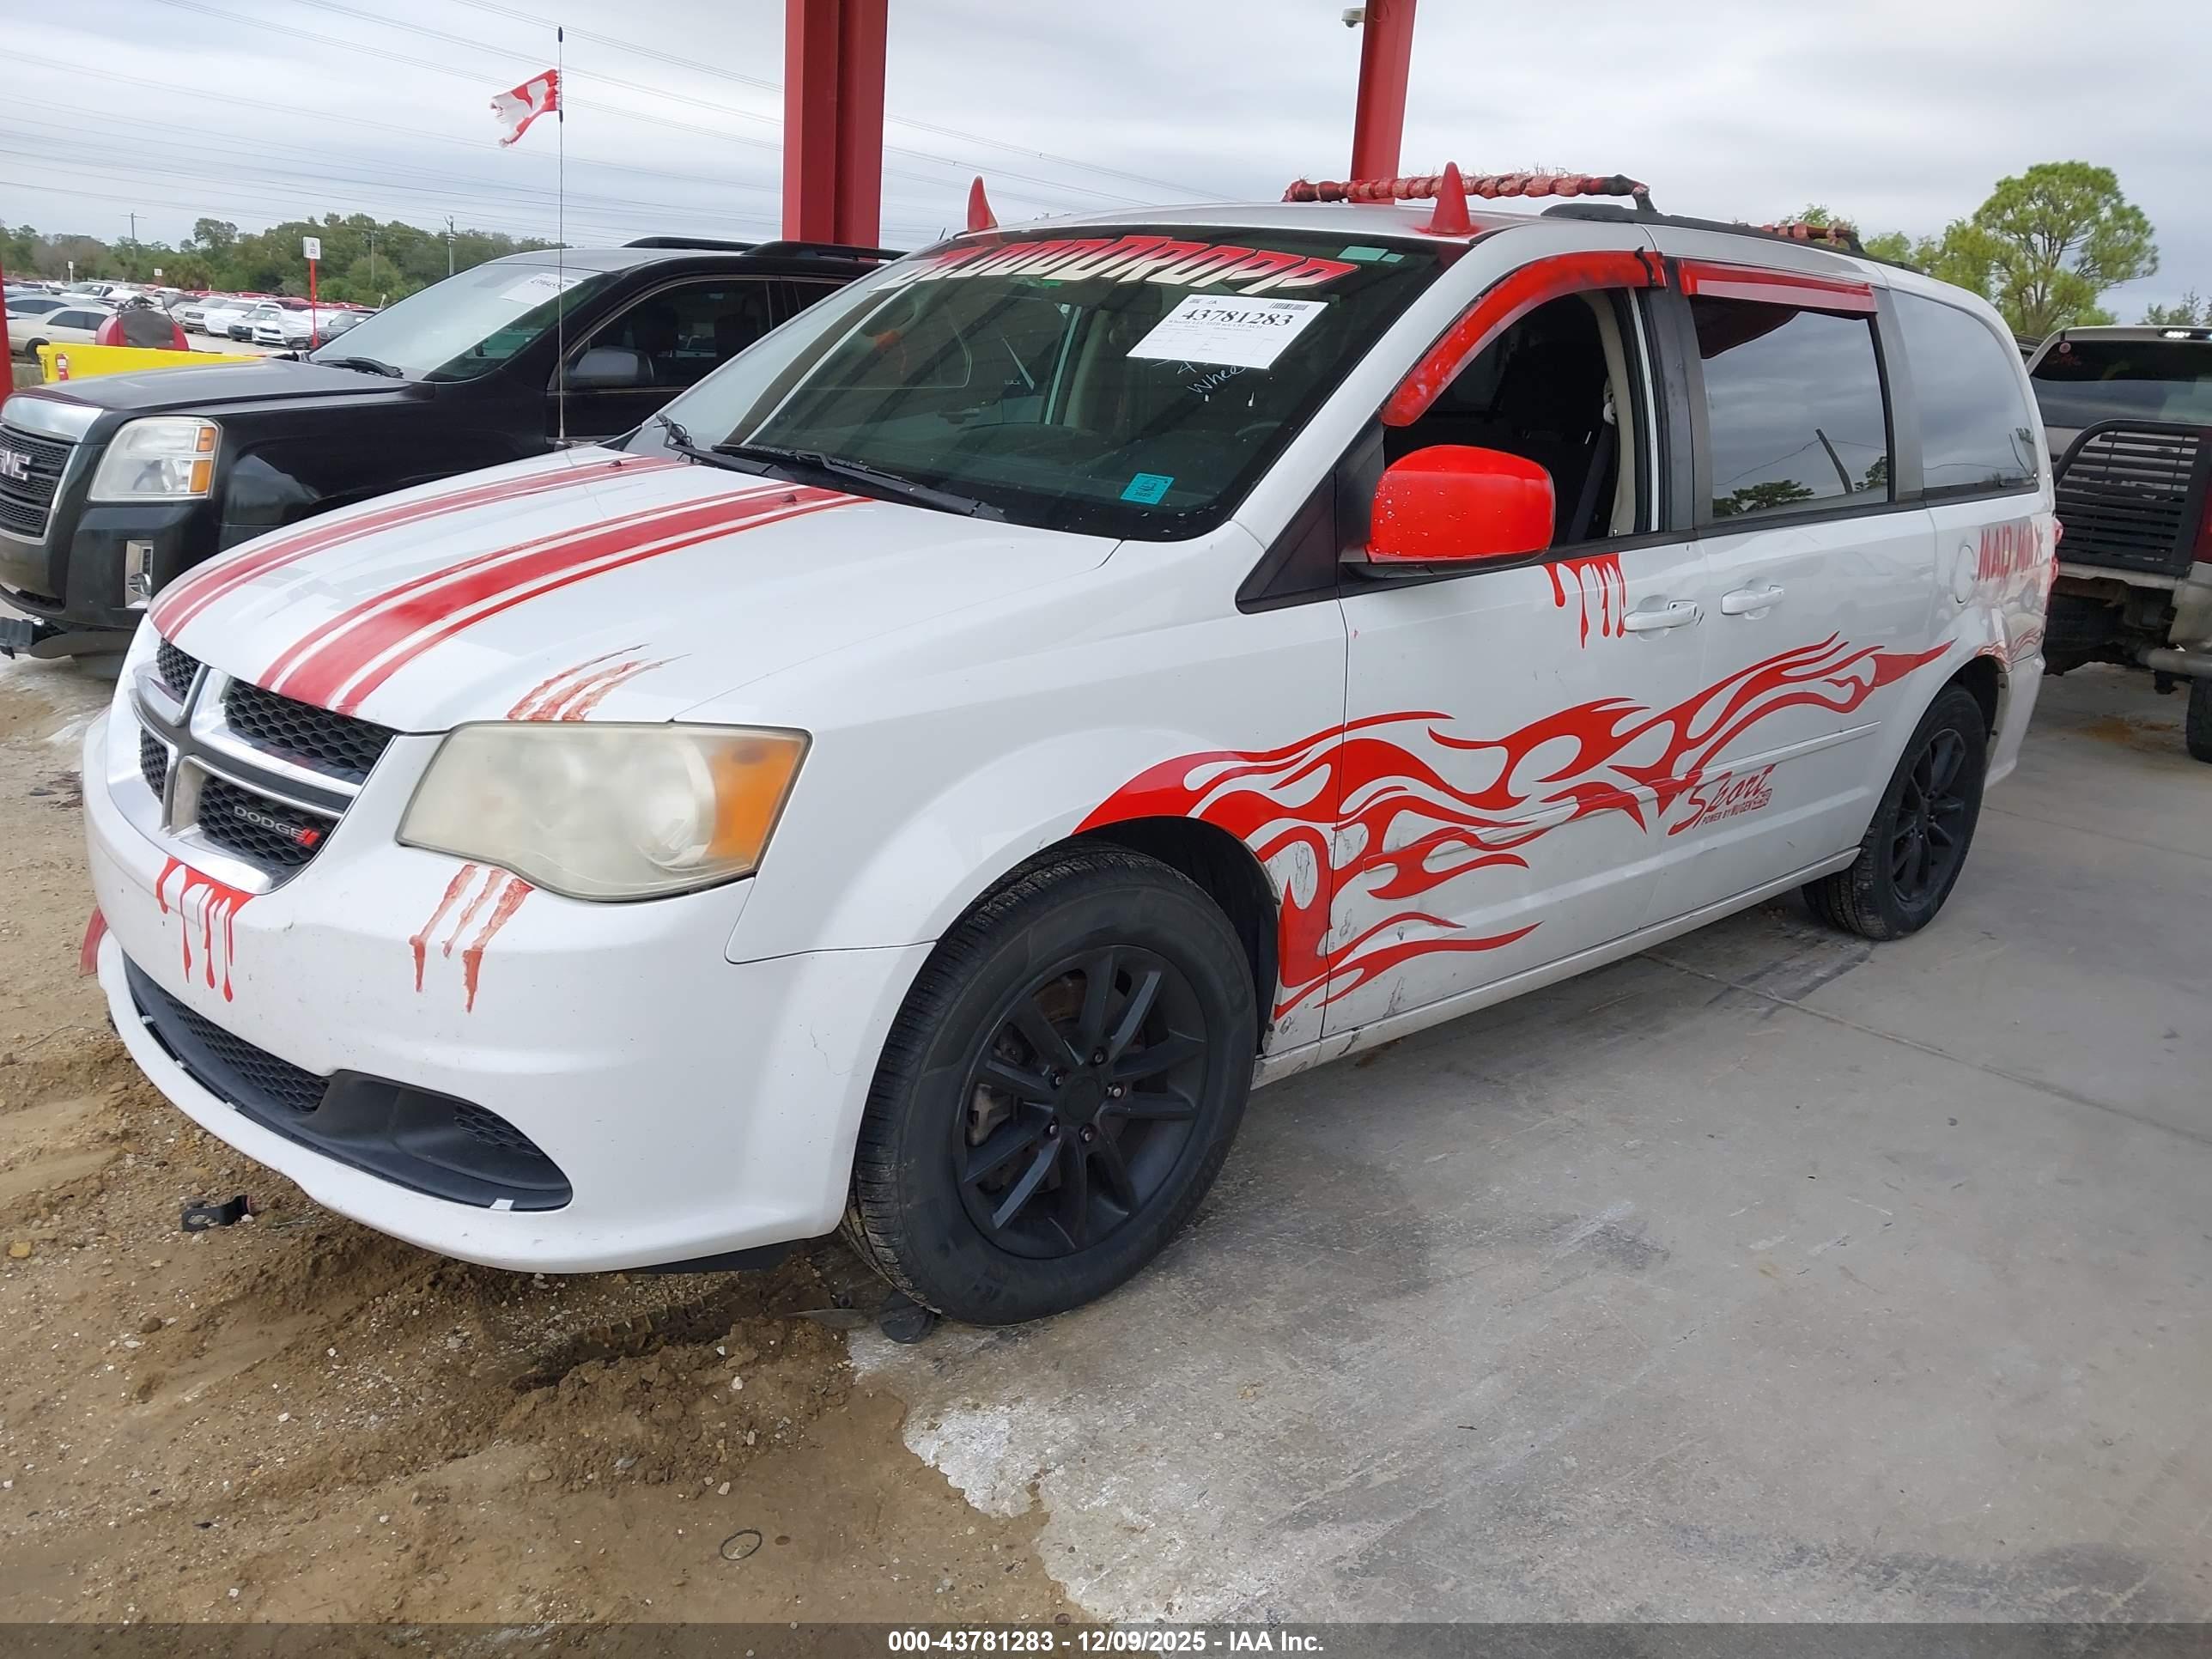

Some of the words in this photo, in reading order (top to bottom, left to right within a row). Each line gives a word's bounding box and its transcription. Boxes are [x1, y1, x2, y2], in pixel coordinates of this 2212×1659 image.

[1182, 308, 1295, 326] 43781283
[1978, 525, 2013, 581] MAD
[234, 805, 306, 840] DODGE
